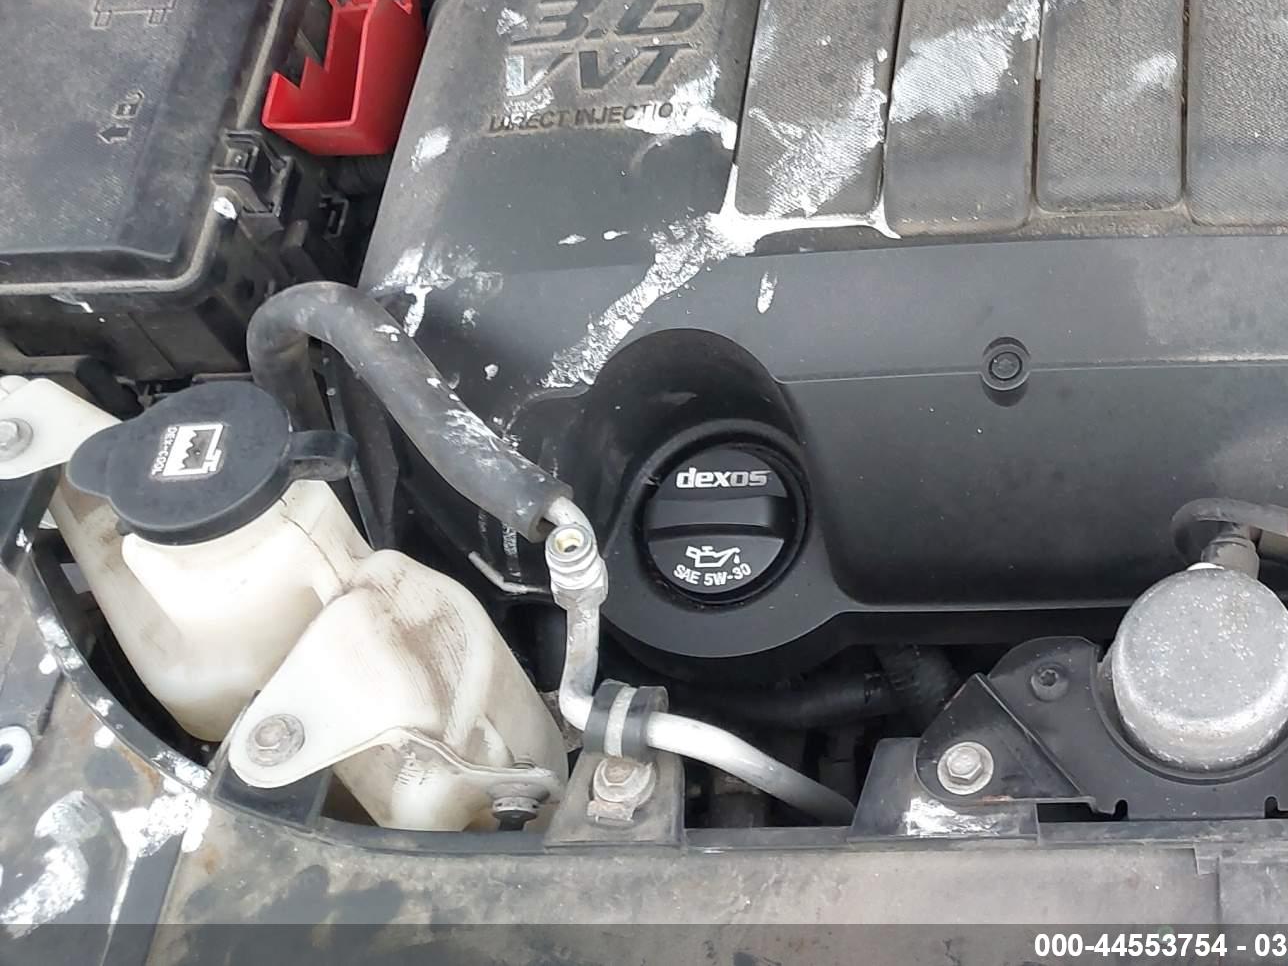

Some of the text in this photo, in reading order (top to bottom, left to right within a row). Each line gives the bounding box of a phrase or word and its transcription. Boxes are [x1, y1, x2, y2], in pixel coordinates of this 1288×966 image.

[505, 42, 694, 97] VVT
[151, 426, 178, 475] DEX-COOL
[676, 467, 772, 489] dexos
[673, 563, 752, 586] SAE 5W-30
